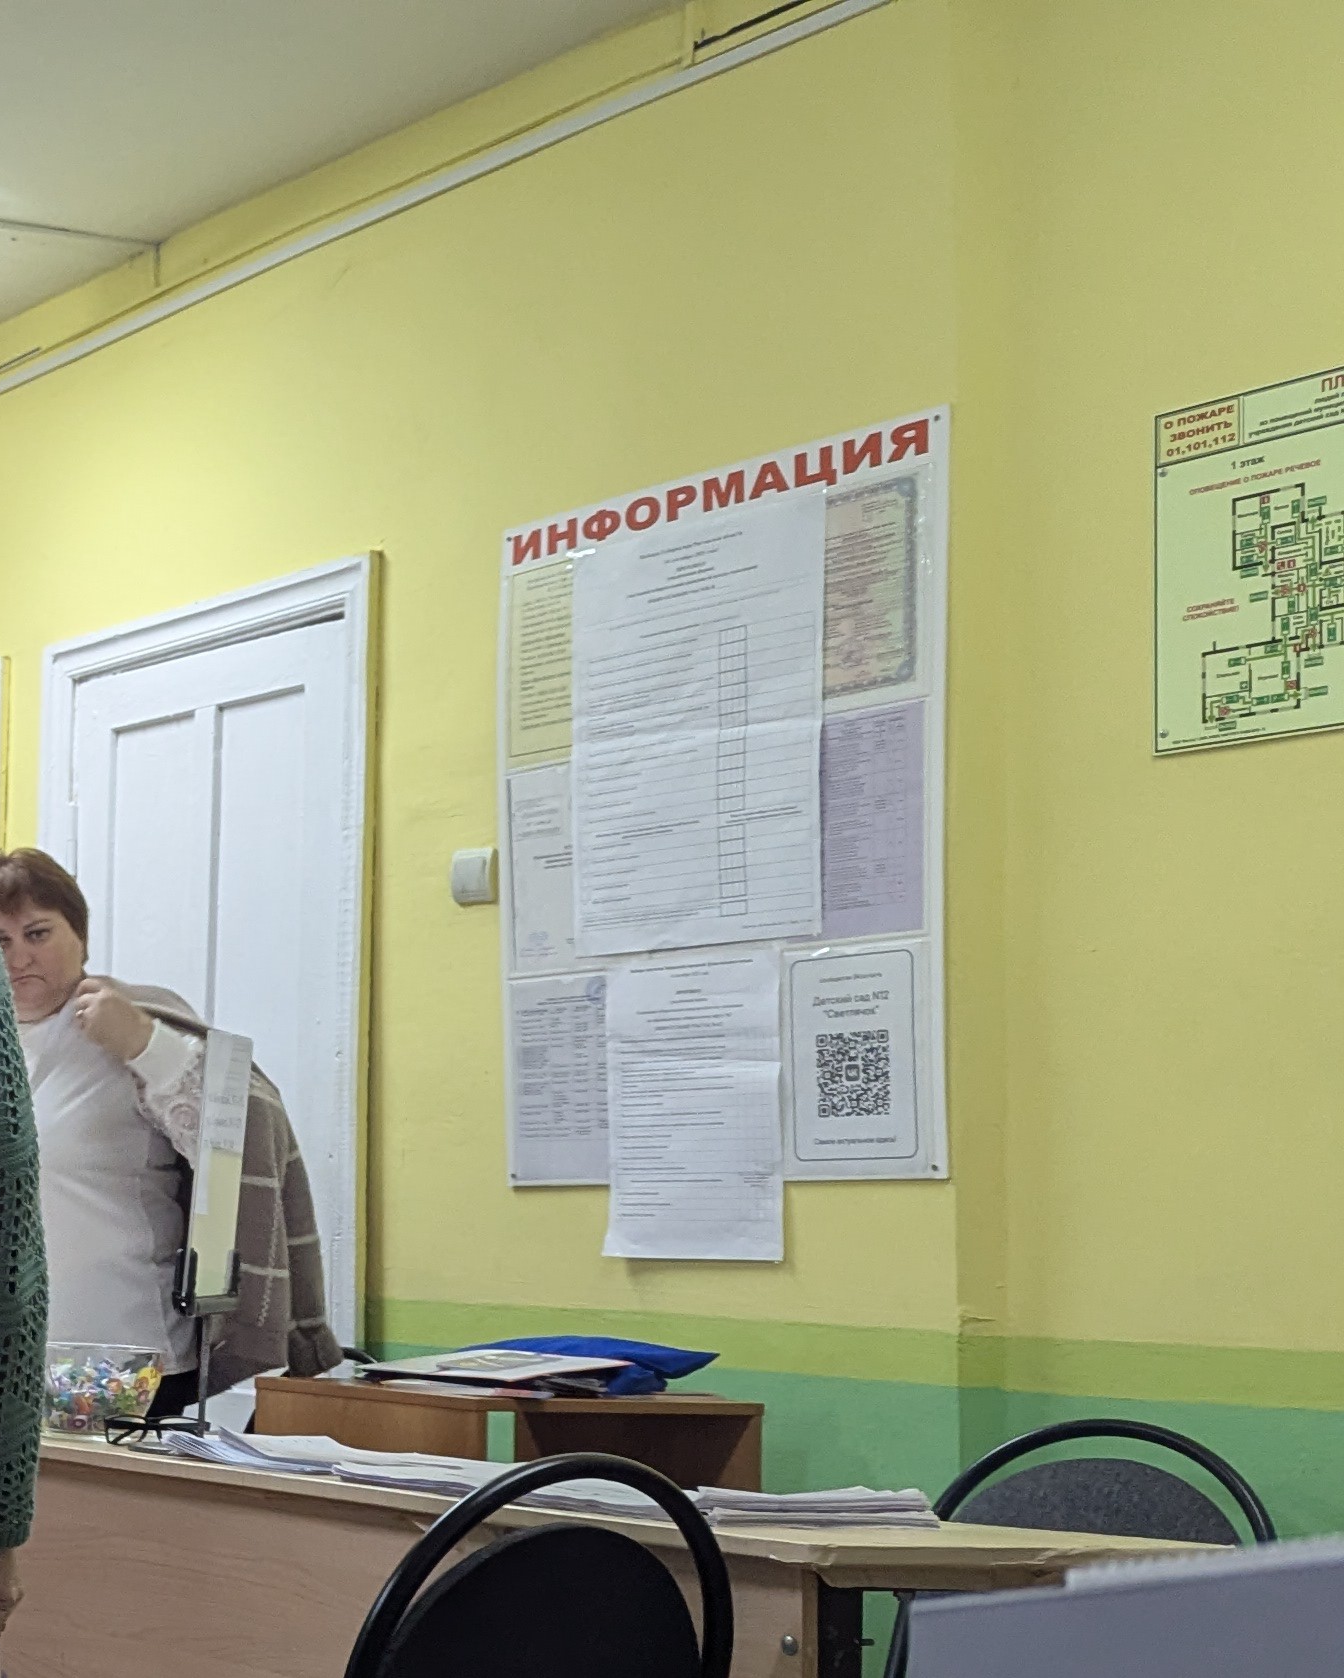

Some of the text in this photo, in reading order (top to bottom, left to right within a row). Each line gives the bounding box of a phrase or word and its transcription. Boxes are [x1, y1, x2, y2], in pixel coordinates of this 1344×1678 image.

[1163, 404, 1235, 430] О ПОЖАРЕ
[1169, 420, 1233, 443] ЗВОНИТЬ
[1231, 455, 1266, 470] 1 этаж
[1189, 478, 1242, 496] ОПОВЕЩЕНИЕ
[1251, 468, 1283, 481] ПОЖАРЕ
[1285, 459, 1322, 473] РЕЧЕВОЕ
[511, 417, 931, 567] ИНФОРМАЦИЯ
[812, 994, 853, 1007] Детский
[854, 993, 871, 1003] сад
